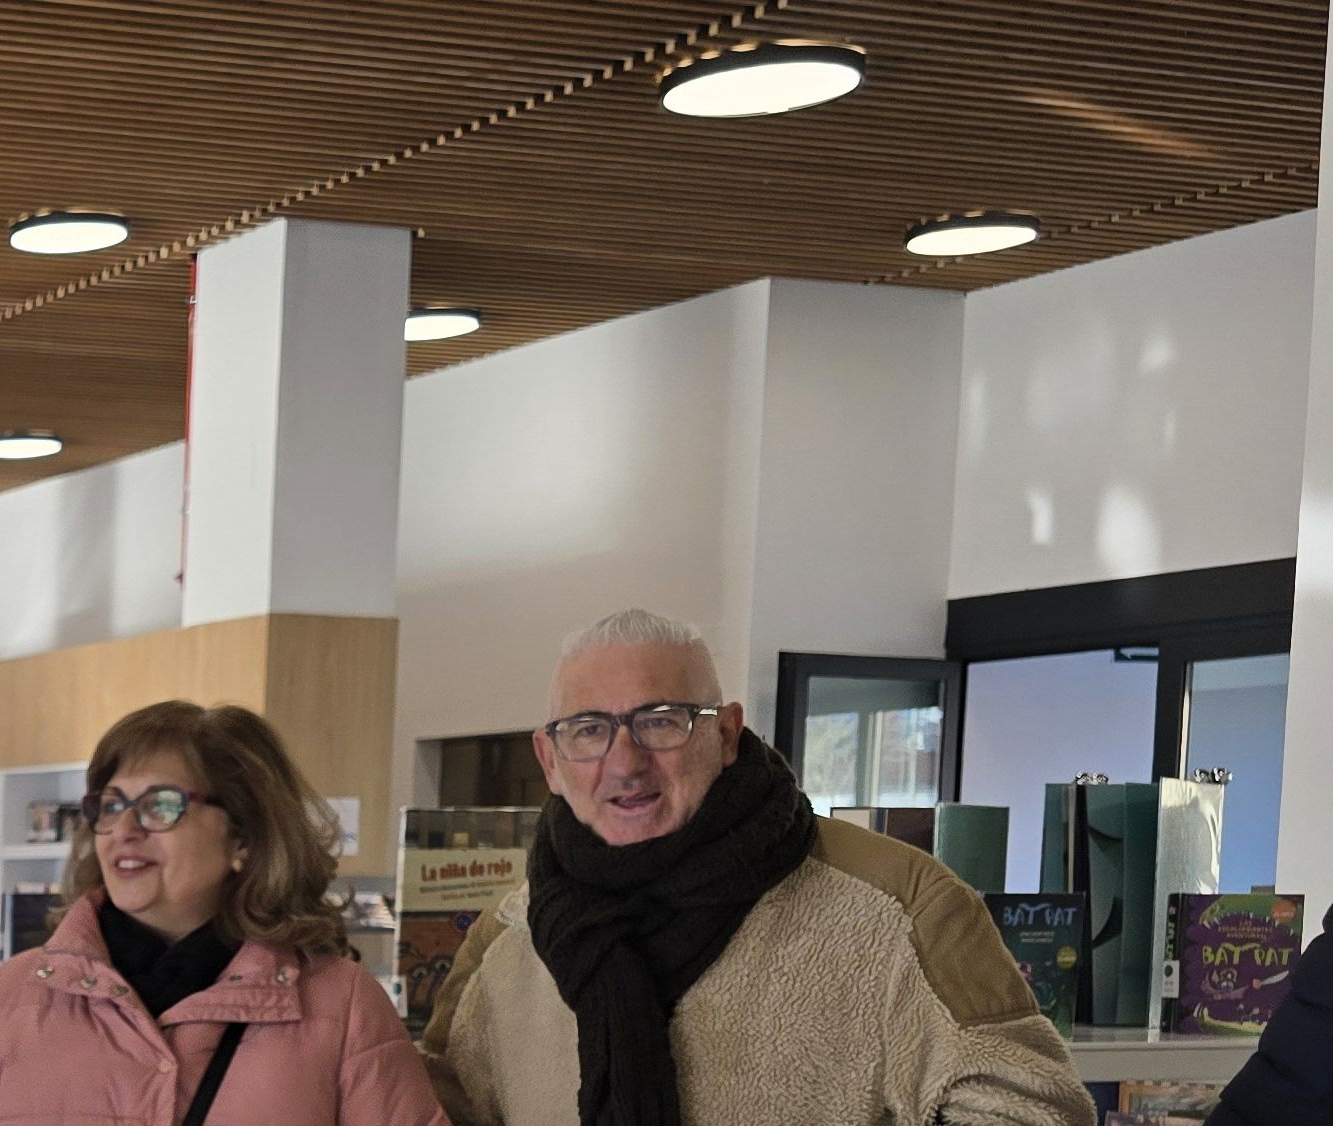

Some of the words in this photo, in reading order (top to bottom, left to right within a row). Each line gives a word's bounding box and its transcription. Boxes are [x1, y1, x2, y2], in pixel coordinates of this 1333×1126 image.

[1003, 902, 1051, 927] BAT
[1044, 906, 1077, 927] PAT
[1202, 942, 1261, 967] BAT
[1253, 947, 1293, 967] PAT
